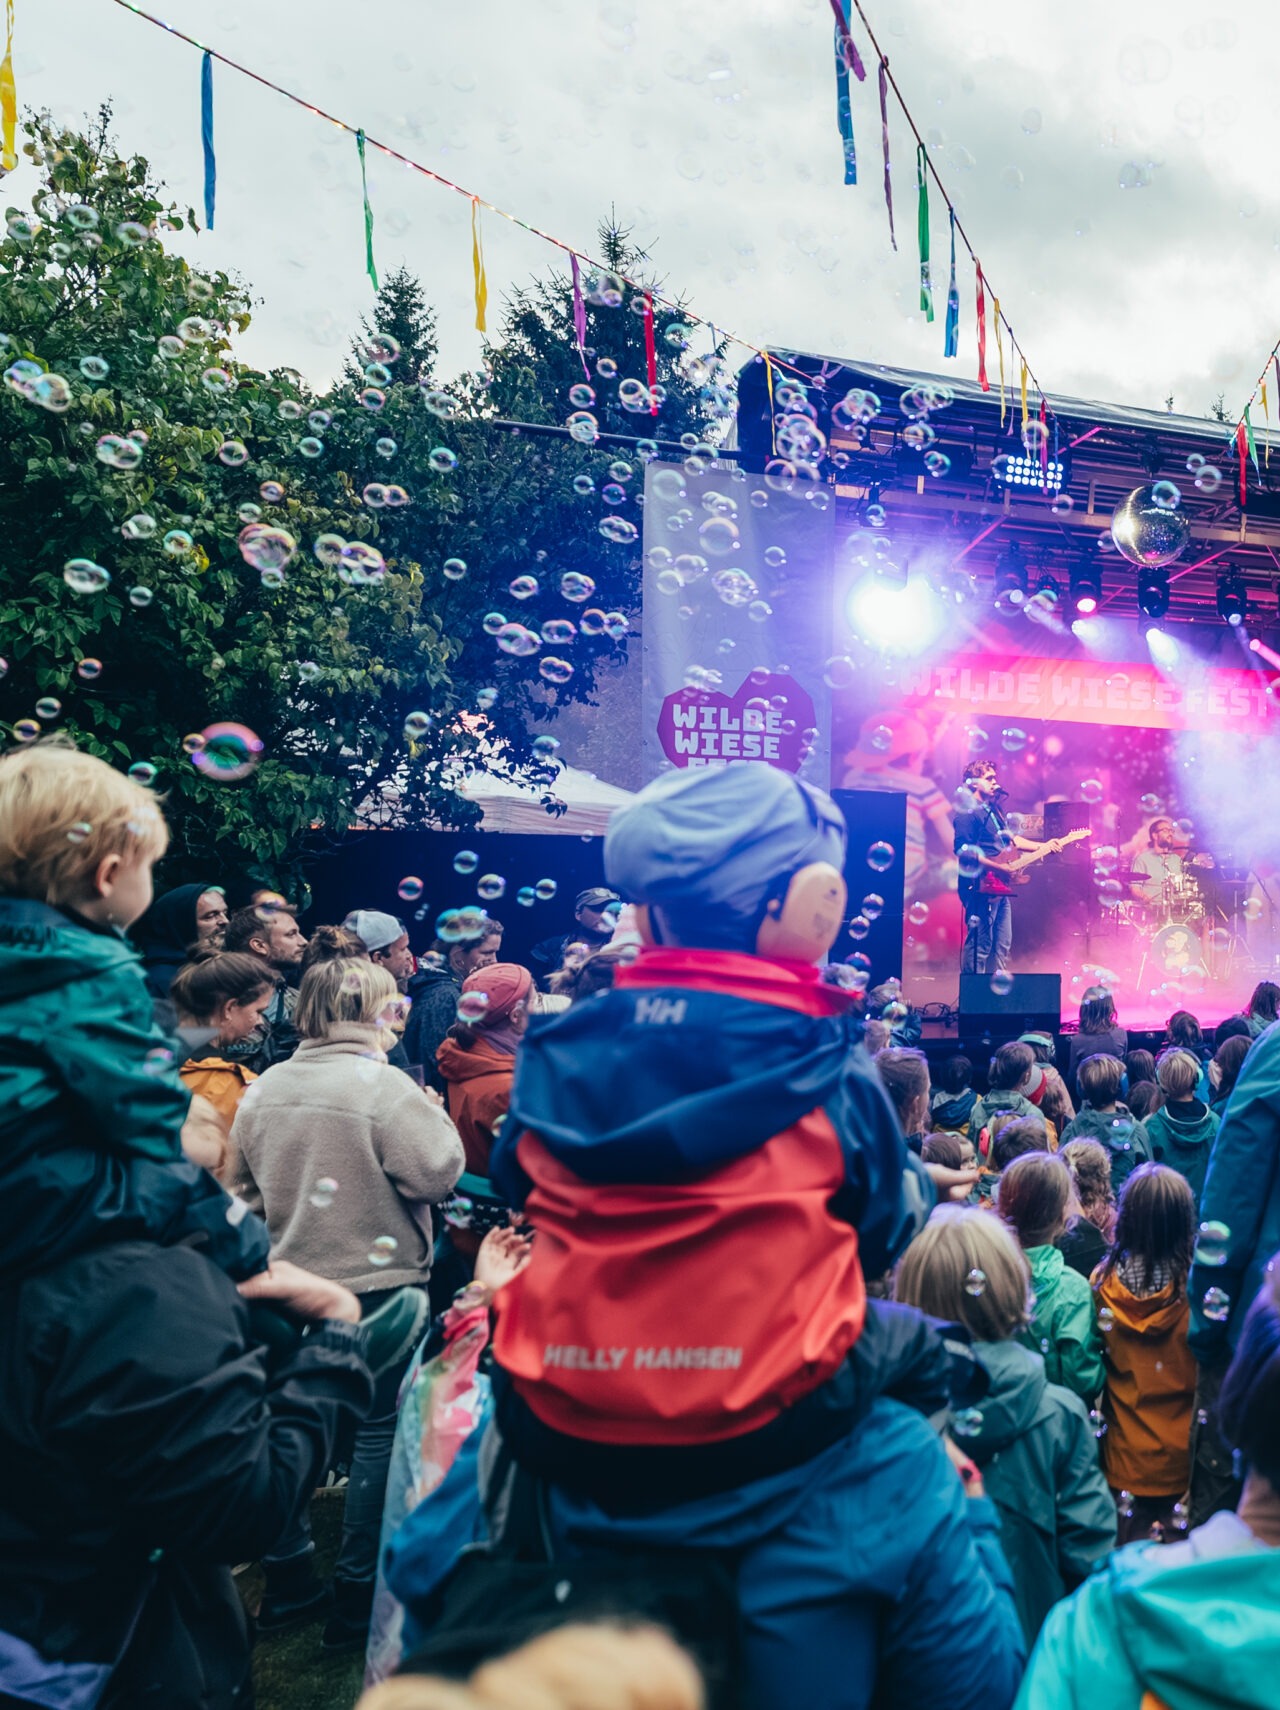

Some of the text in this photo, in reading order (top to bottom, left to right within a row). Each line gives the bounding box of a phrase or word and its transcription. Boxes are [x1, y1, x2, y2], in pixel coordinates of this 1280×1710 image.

[901, 665, 1270, 717] WILDE WIESE FEST
[672, 703, 783, 735] WILDE
[674, 730, 780, 760] WIESE
[634, 997, 688, 1025] HH
[543, 1345, 743, 1371] HELLY HANSEN
